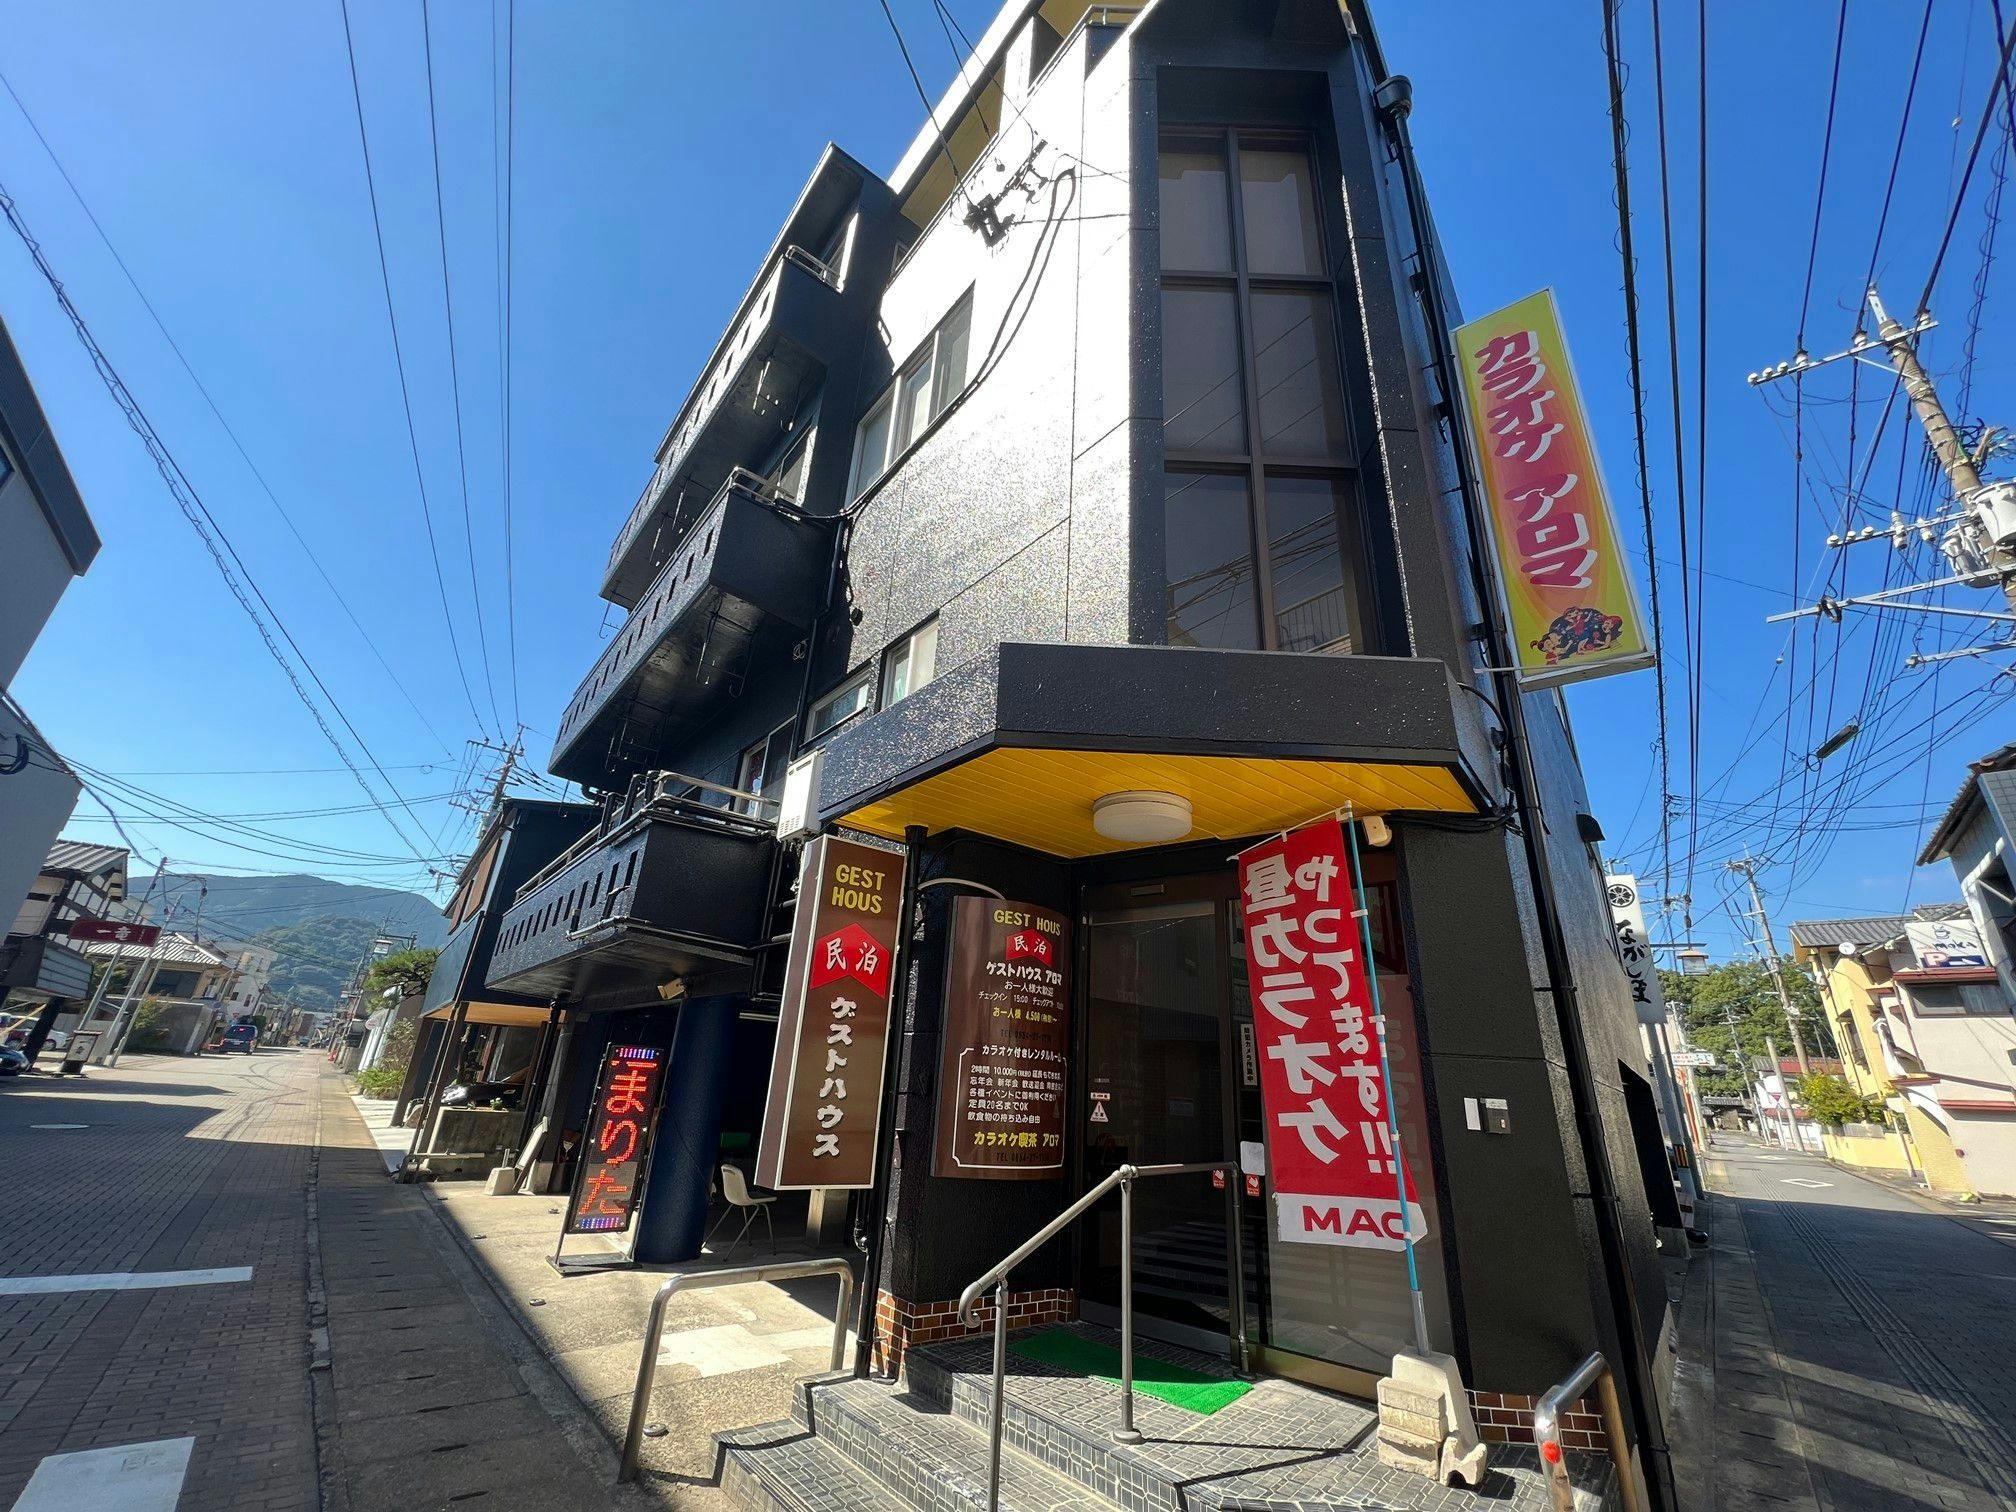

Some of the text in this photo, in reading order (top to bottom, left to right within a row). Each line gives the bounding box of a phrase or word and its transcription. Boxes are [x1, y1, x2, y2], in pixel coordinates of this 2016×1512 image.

[1475, 331, 1598, 588] カラオケ アロマ
[835, 864, 886, 891] GEST
[831, 886, 883, 914] HOUS
[993, 909, 1061, 936] GEST HOUS
[826, 937, 879, 975] 民泊
[1013, 935, 1047, 955] 民泊
[986, 961, 1062, 985] ゲストハウス アロマ
[812, 996, 857, 1157] ゲストハウス
[579, 1060, 658, 1215] まりた
[974, 1131, 1060, 1147] カラオケ喫茶 アロマ
